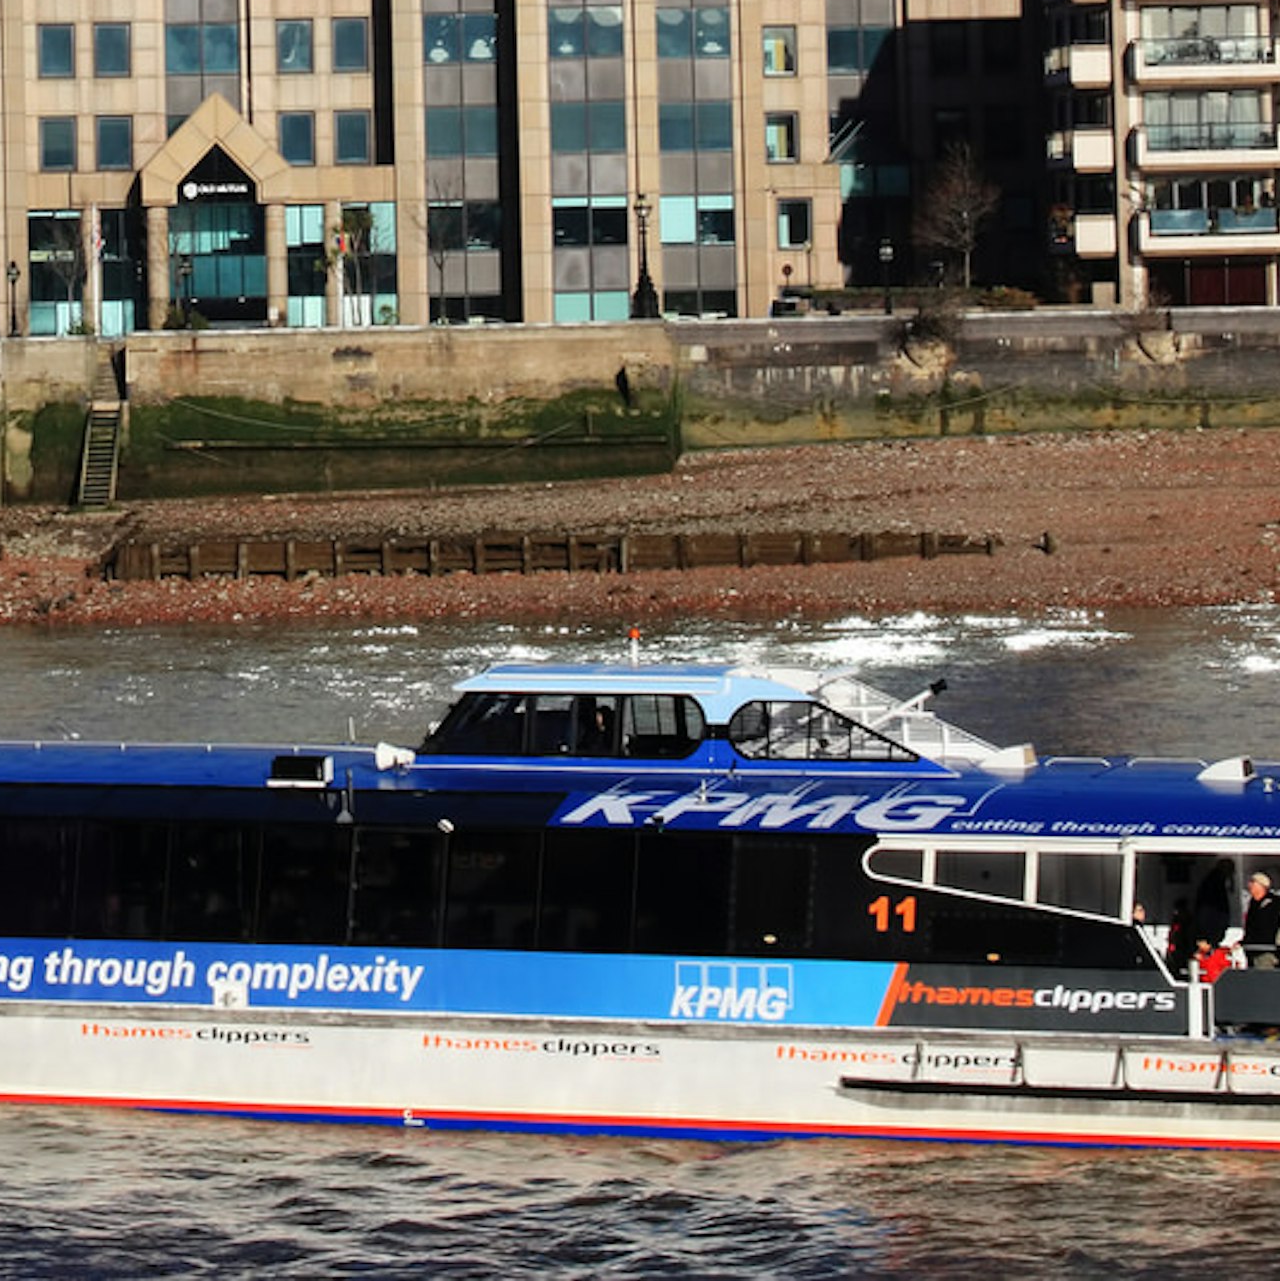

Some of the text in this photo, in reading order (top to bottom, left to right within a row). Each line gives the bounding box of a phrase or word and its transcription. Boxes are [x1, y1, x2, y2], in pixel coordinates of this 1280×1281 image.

[561, 792, 966, 830] KPMG
[951, 820, 1043, 835] cutting
[1051, 820, 1156, 836] through
[868, 895, 917, 933] 11
[44, 947, 196, 996] through
[206, 953, 425, 1002] complexity
[670, 984, 788, 1020] KPMG
